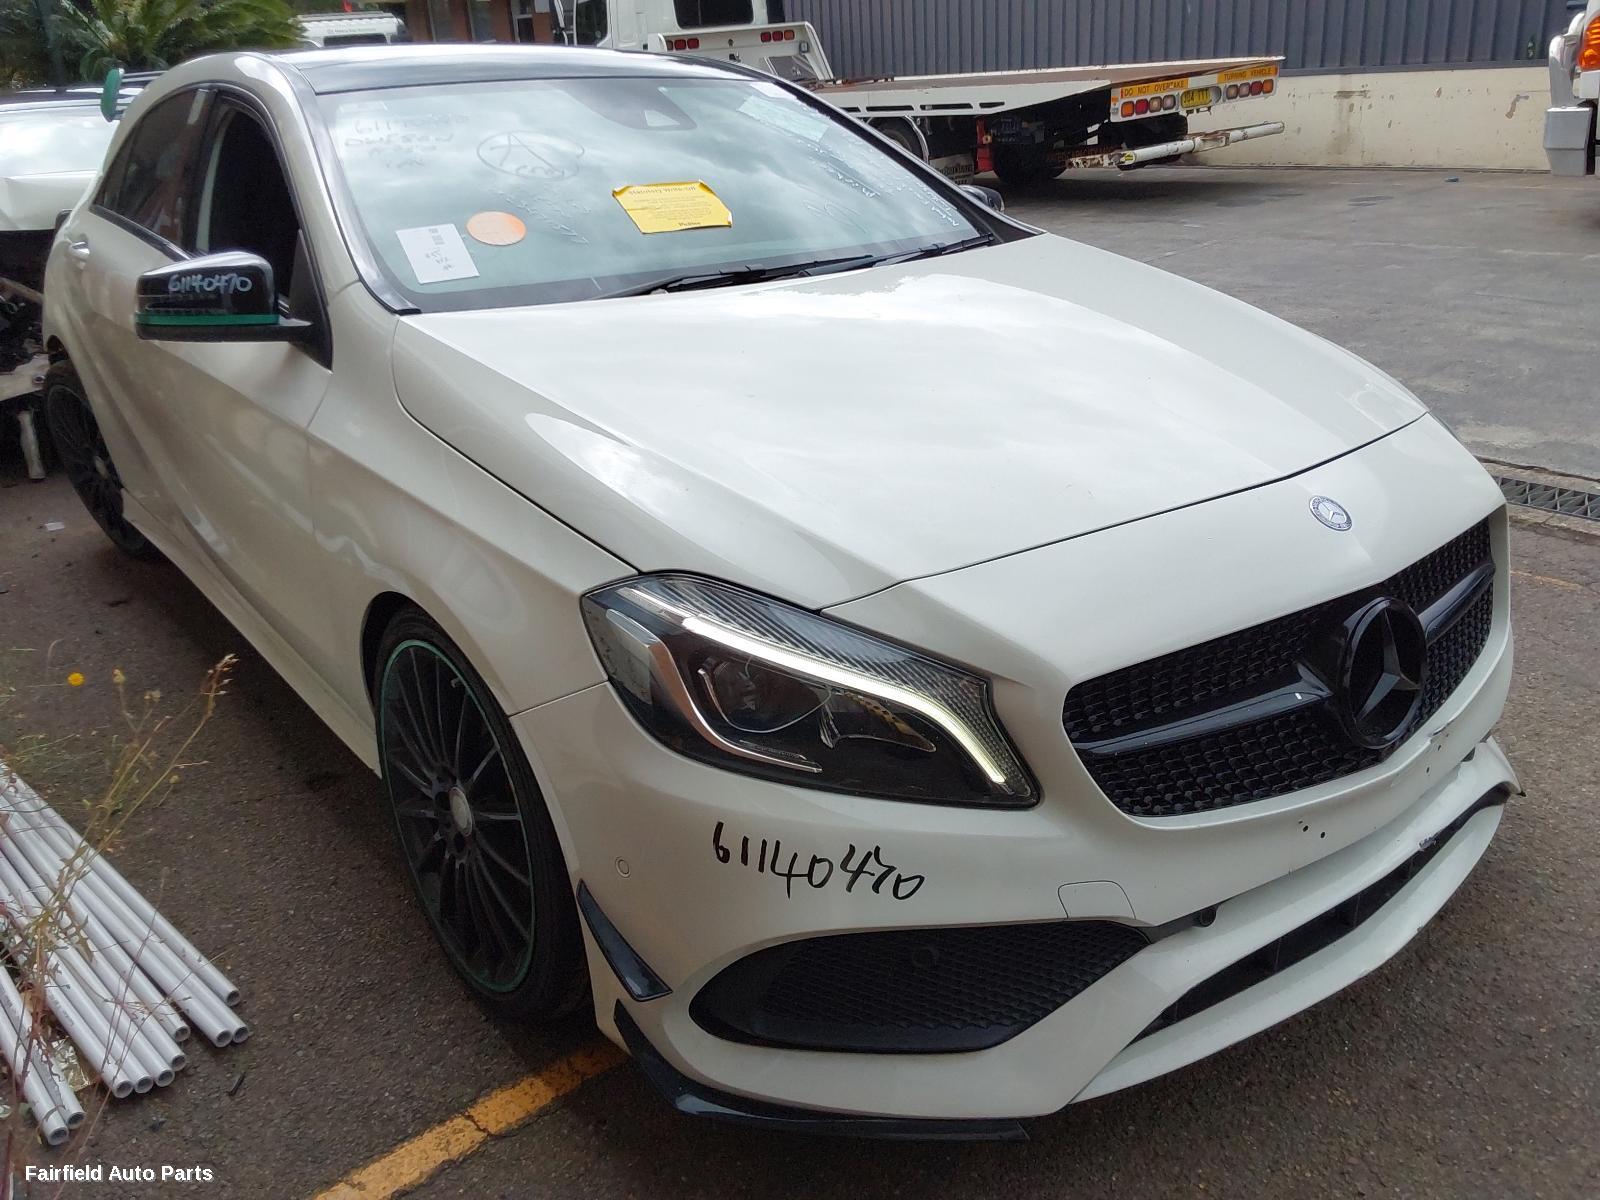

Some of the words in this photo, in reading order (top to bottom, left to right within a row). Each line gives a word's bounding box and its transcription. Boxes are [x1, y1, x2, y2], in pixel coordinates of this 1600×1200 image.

[1224, 72, 1247, 81] TURNING
[1250, 67, 1272, 77] VEHICLE
[1124, 88, 1133, 97] DO
[1137, 86, 1150, 95] NOT
[168, 273, 253, 295] 61140470
[713, 821, 925, 901] 61140470
